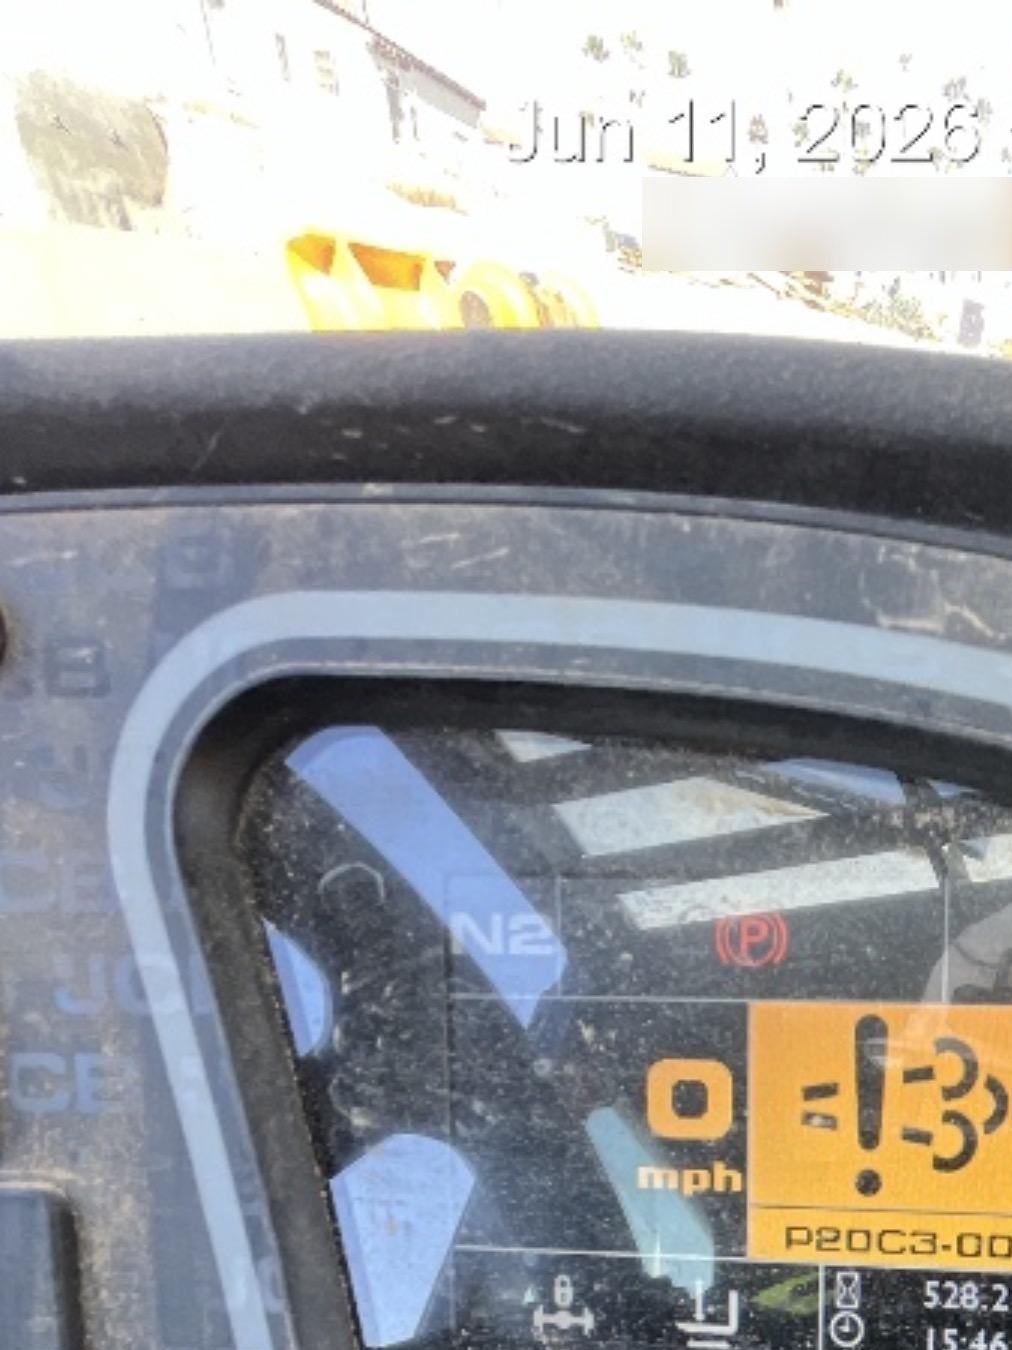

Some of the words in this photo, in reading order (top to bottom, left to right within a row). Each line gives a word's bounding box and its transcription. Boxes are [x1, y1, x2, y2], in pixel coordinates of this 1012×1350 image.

[451, 911, 556, 956] N2
[647, 1058, 733, 1139] 0
[637, 1161, 742, 1197] mph
[922, 1279, 1010, 1313] 528.2
